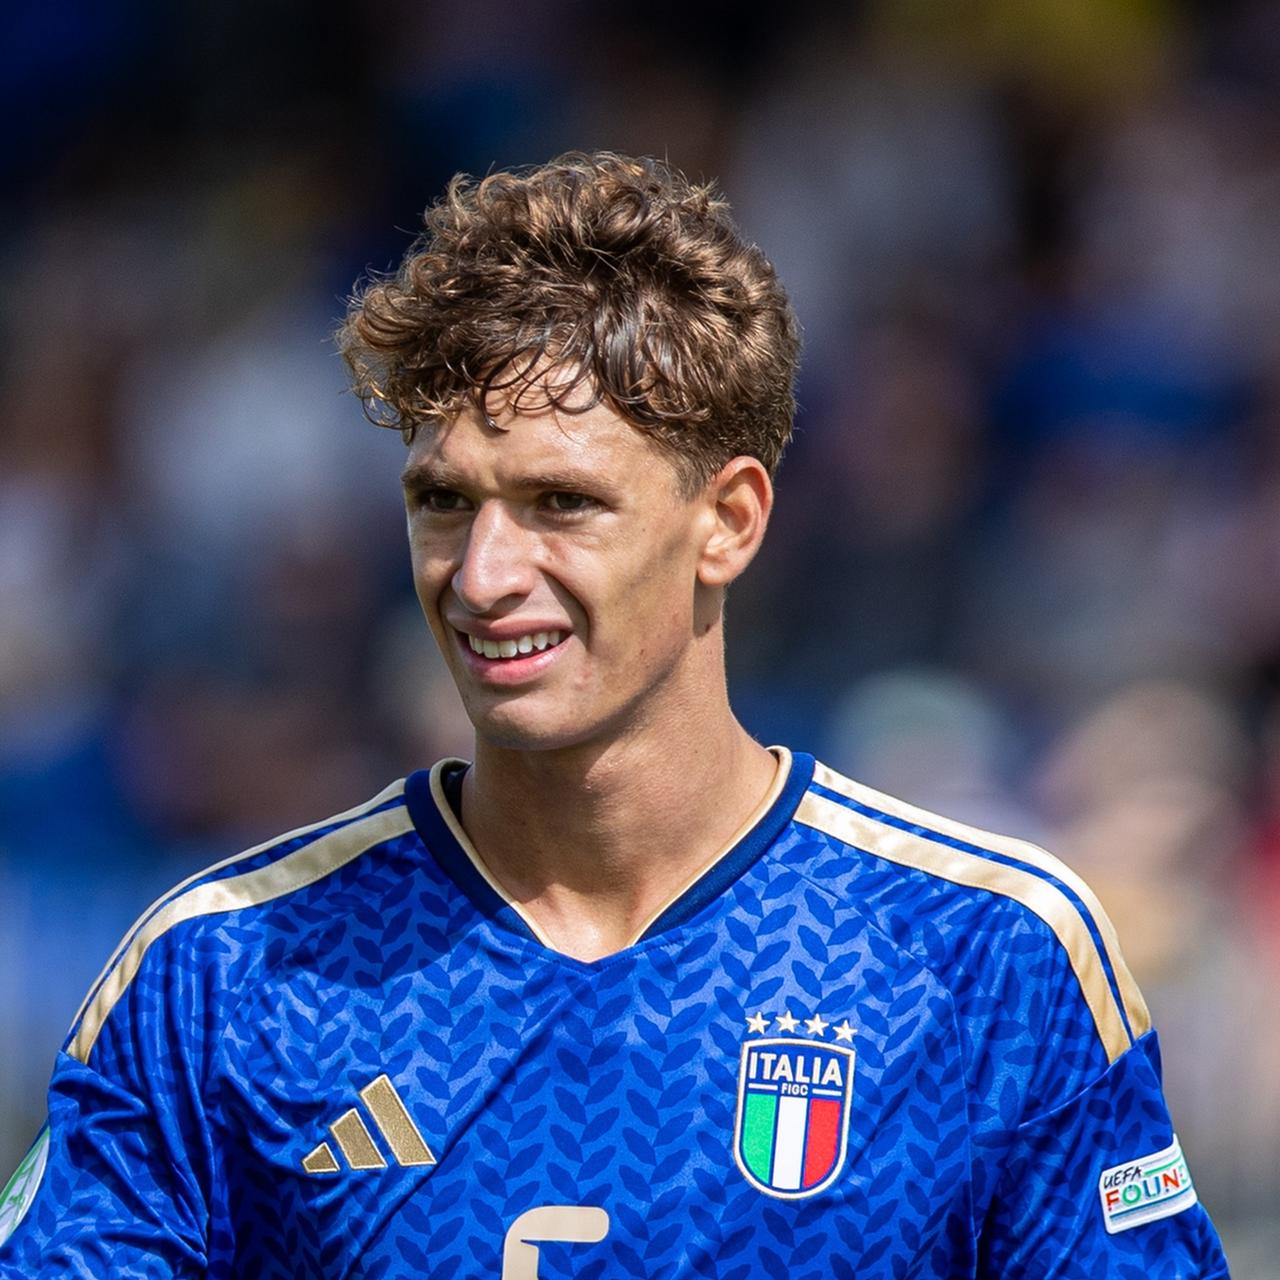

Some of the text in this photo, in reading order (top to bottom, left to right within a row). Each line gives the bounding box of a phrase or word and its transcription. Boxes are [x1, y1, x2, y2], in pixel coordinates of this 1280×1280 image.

[748, 1052, 843, 1086] ITALIA
[781, 1083, 809, 1096] FIGC
[1104, 1166, 1142, 1189] UEFA
